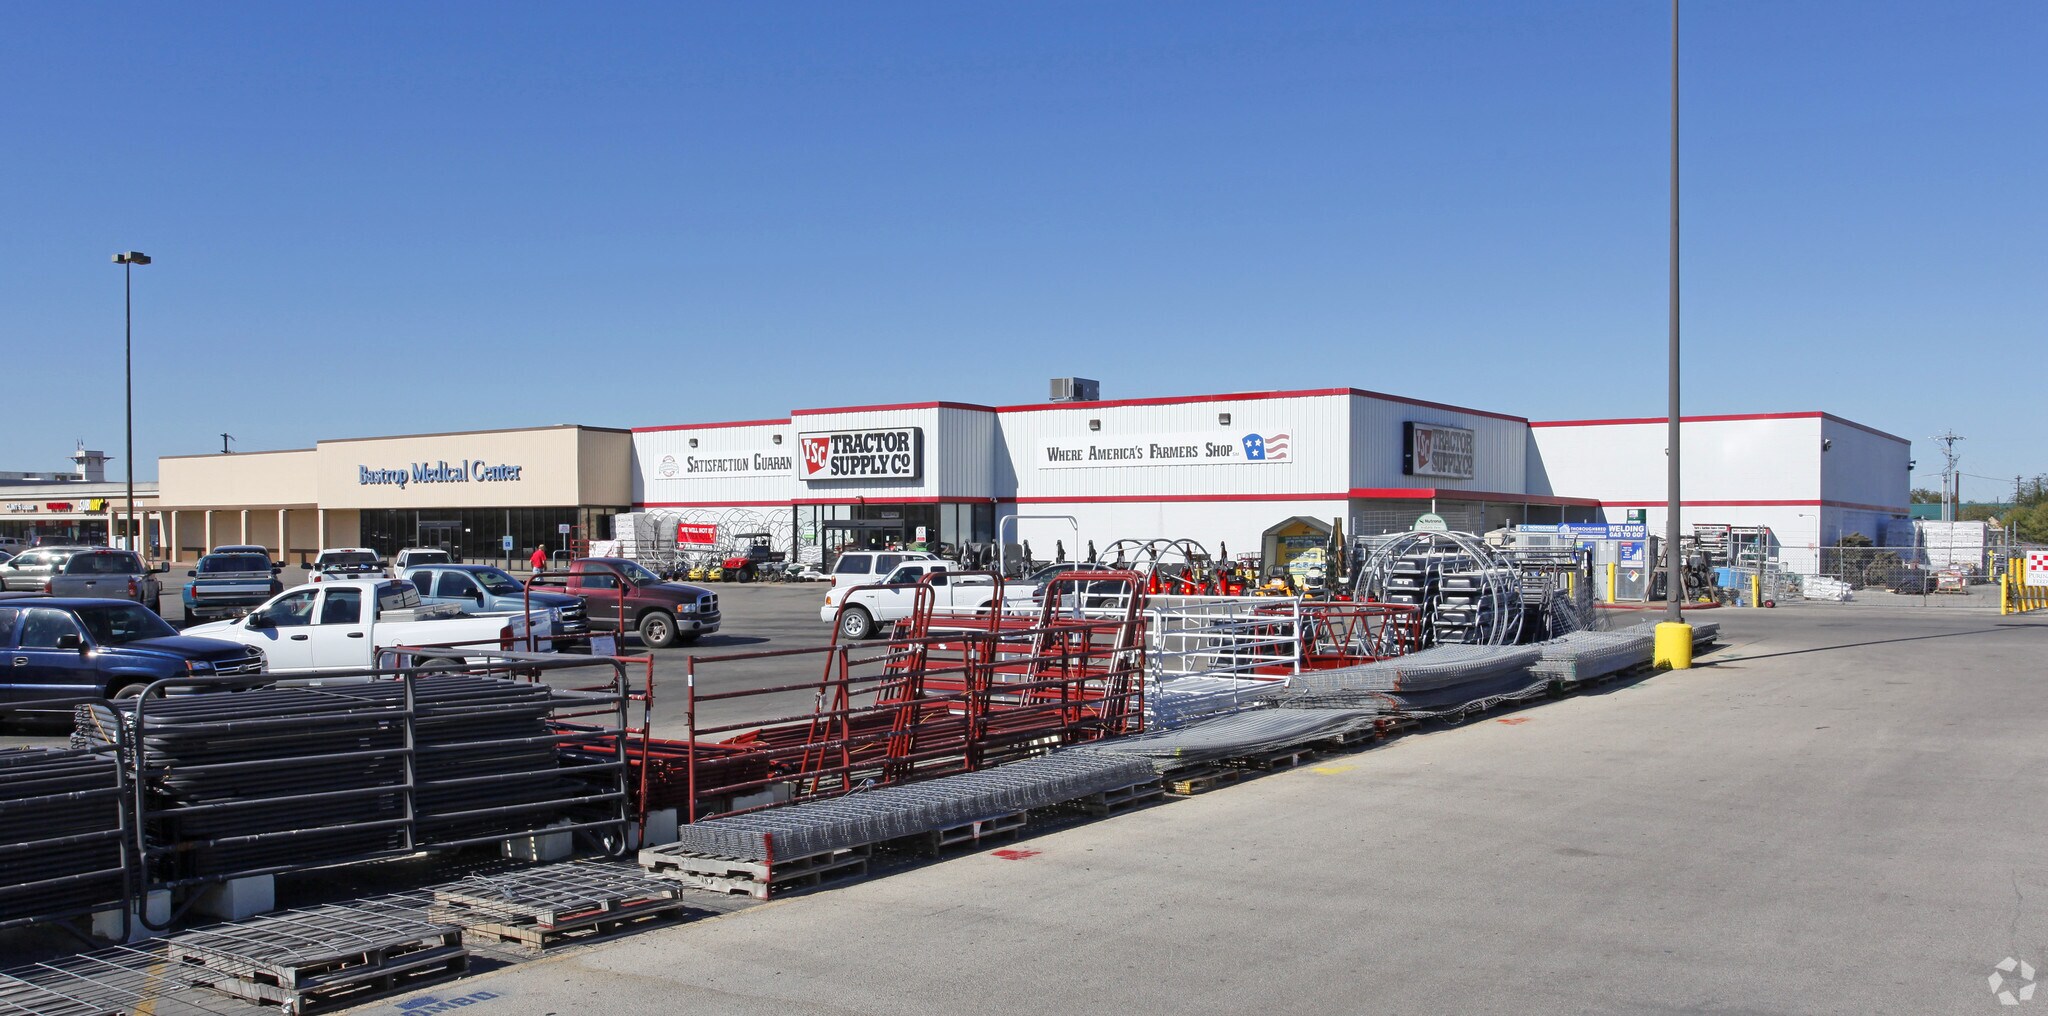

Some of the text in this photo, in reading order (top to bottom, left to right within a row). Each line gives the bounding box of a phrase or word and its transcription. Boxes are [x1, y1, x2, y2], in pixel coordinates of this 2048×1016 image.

[830, 432, 910, 454] TRACTOR
[1046, 446, 1083, 462] WHERE
[1088, 445, 1143, 461] AMERICA'S
[1150, 443, 1198, 459] FARMERS
[1205, 441, 1233, 457] SHOP
[1416, 429, 1430, 462] TSC
[1432, 429, 1472, 454] TRACTOR
[687, 456, 749, 473] SATISFACTION
[804, 439, 826, 468] TSC
[1431, 452, 1462, 474] SUPPLY
[358, 459, 522, 489] Bastrop Medical Center
[830, 454, 890, 476] SUPPLY
[78, 498, 104, 512] SUBWAY
